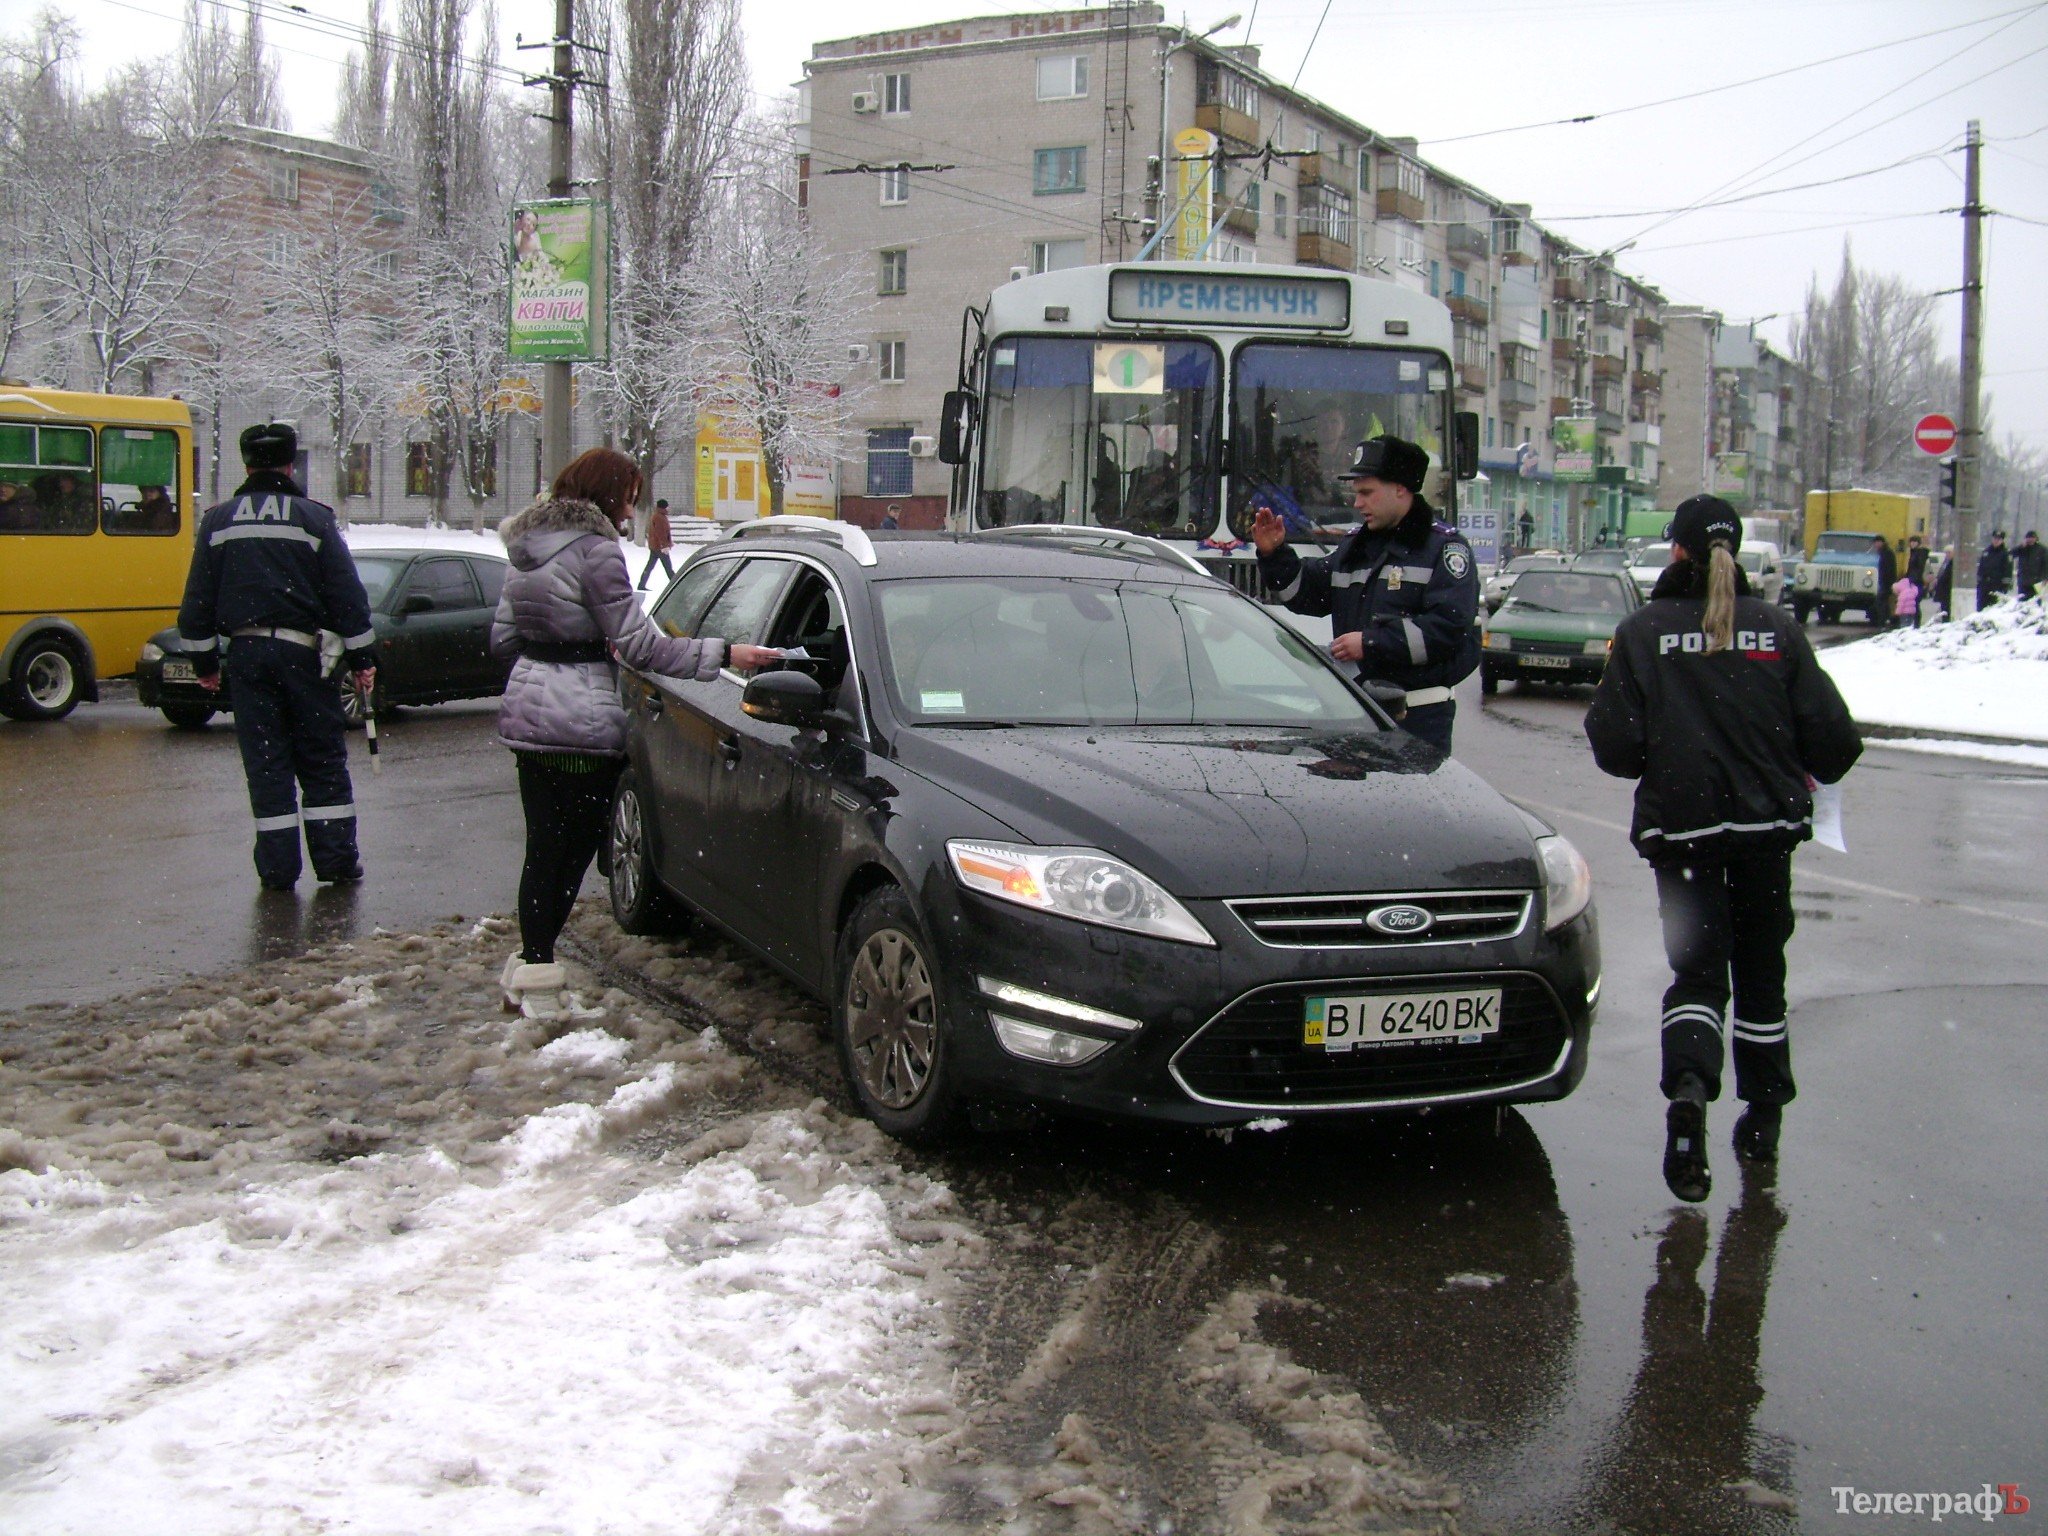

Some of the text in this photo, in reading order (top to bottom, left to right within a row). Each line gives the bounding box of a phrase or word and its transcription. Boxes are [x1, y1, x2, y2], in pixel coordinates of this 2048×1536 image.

[519, 287, 584, 299] МАГАЗИН
[1137, 277, 1319, 316] КРЕМЕНЧУК
[516, 301, 584, 320] КВІТИ
[1119, 353, 1135, 387] 1
[232, 494, 293, 521] ДАІ
[1458, 515, 1496, 530] ВЕБ
[1389, 911, 1418, 926] Ford
[1327, 995, 1495, 1038] BI 6240 BK
[1308, 1028, 1321, 1037] UA
